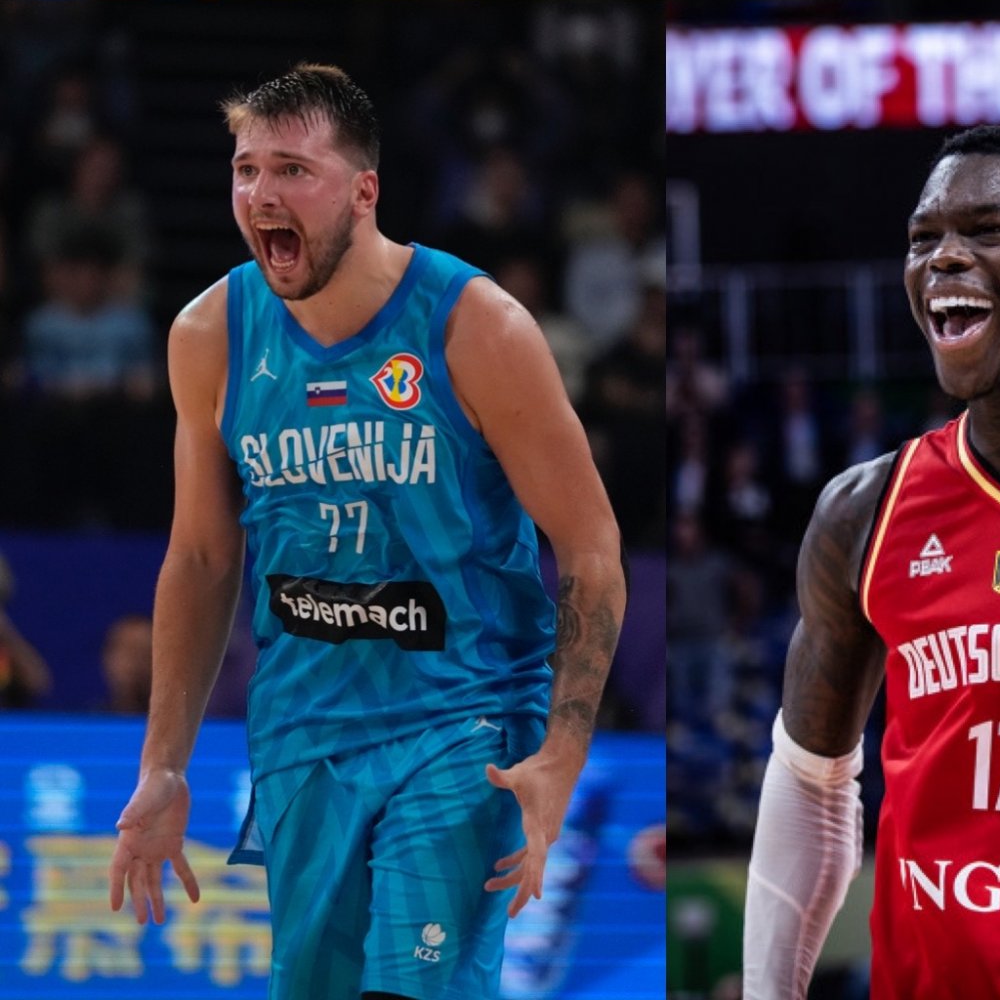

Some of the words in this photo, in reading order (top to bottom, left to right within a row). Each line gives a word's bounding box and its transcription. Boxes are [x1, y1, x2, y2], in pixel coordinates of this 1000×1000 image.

[801, 25, 900, 131] OF
[241, 421, 435, 487] SLOVENIJA
[319, 500, 368, 554] 77
[909, 555, 953, 578] PEAK
[280, 592, 427, 631] telemach
[413, 945, 441, 962] KZS
